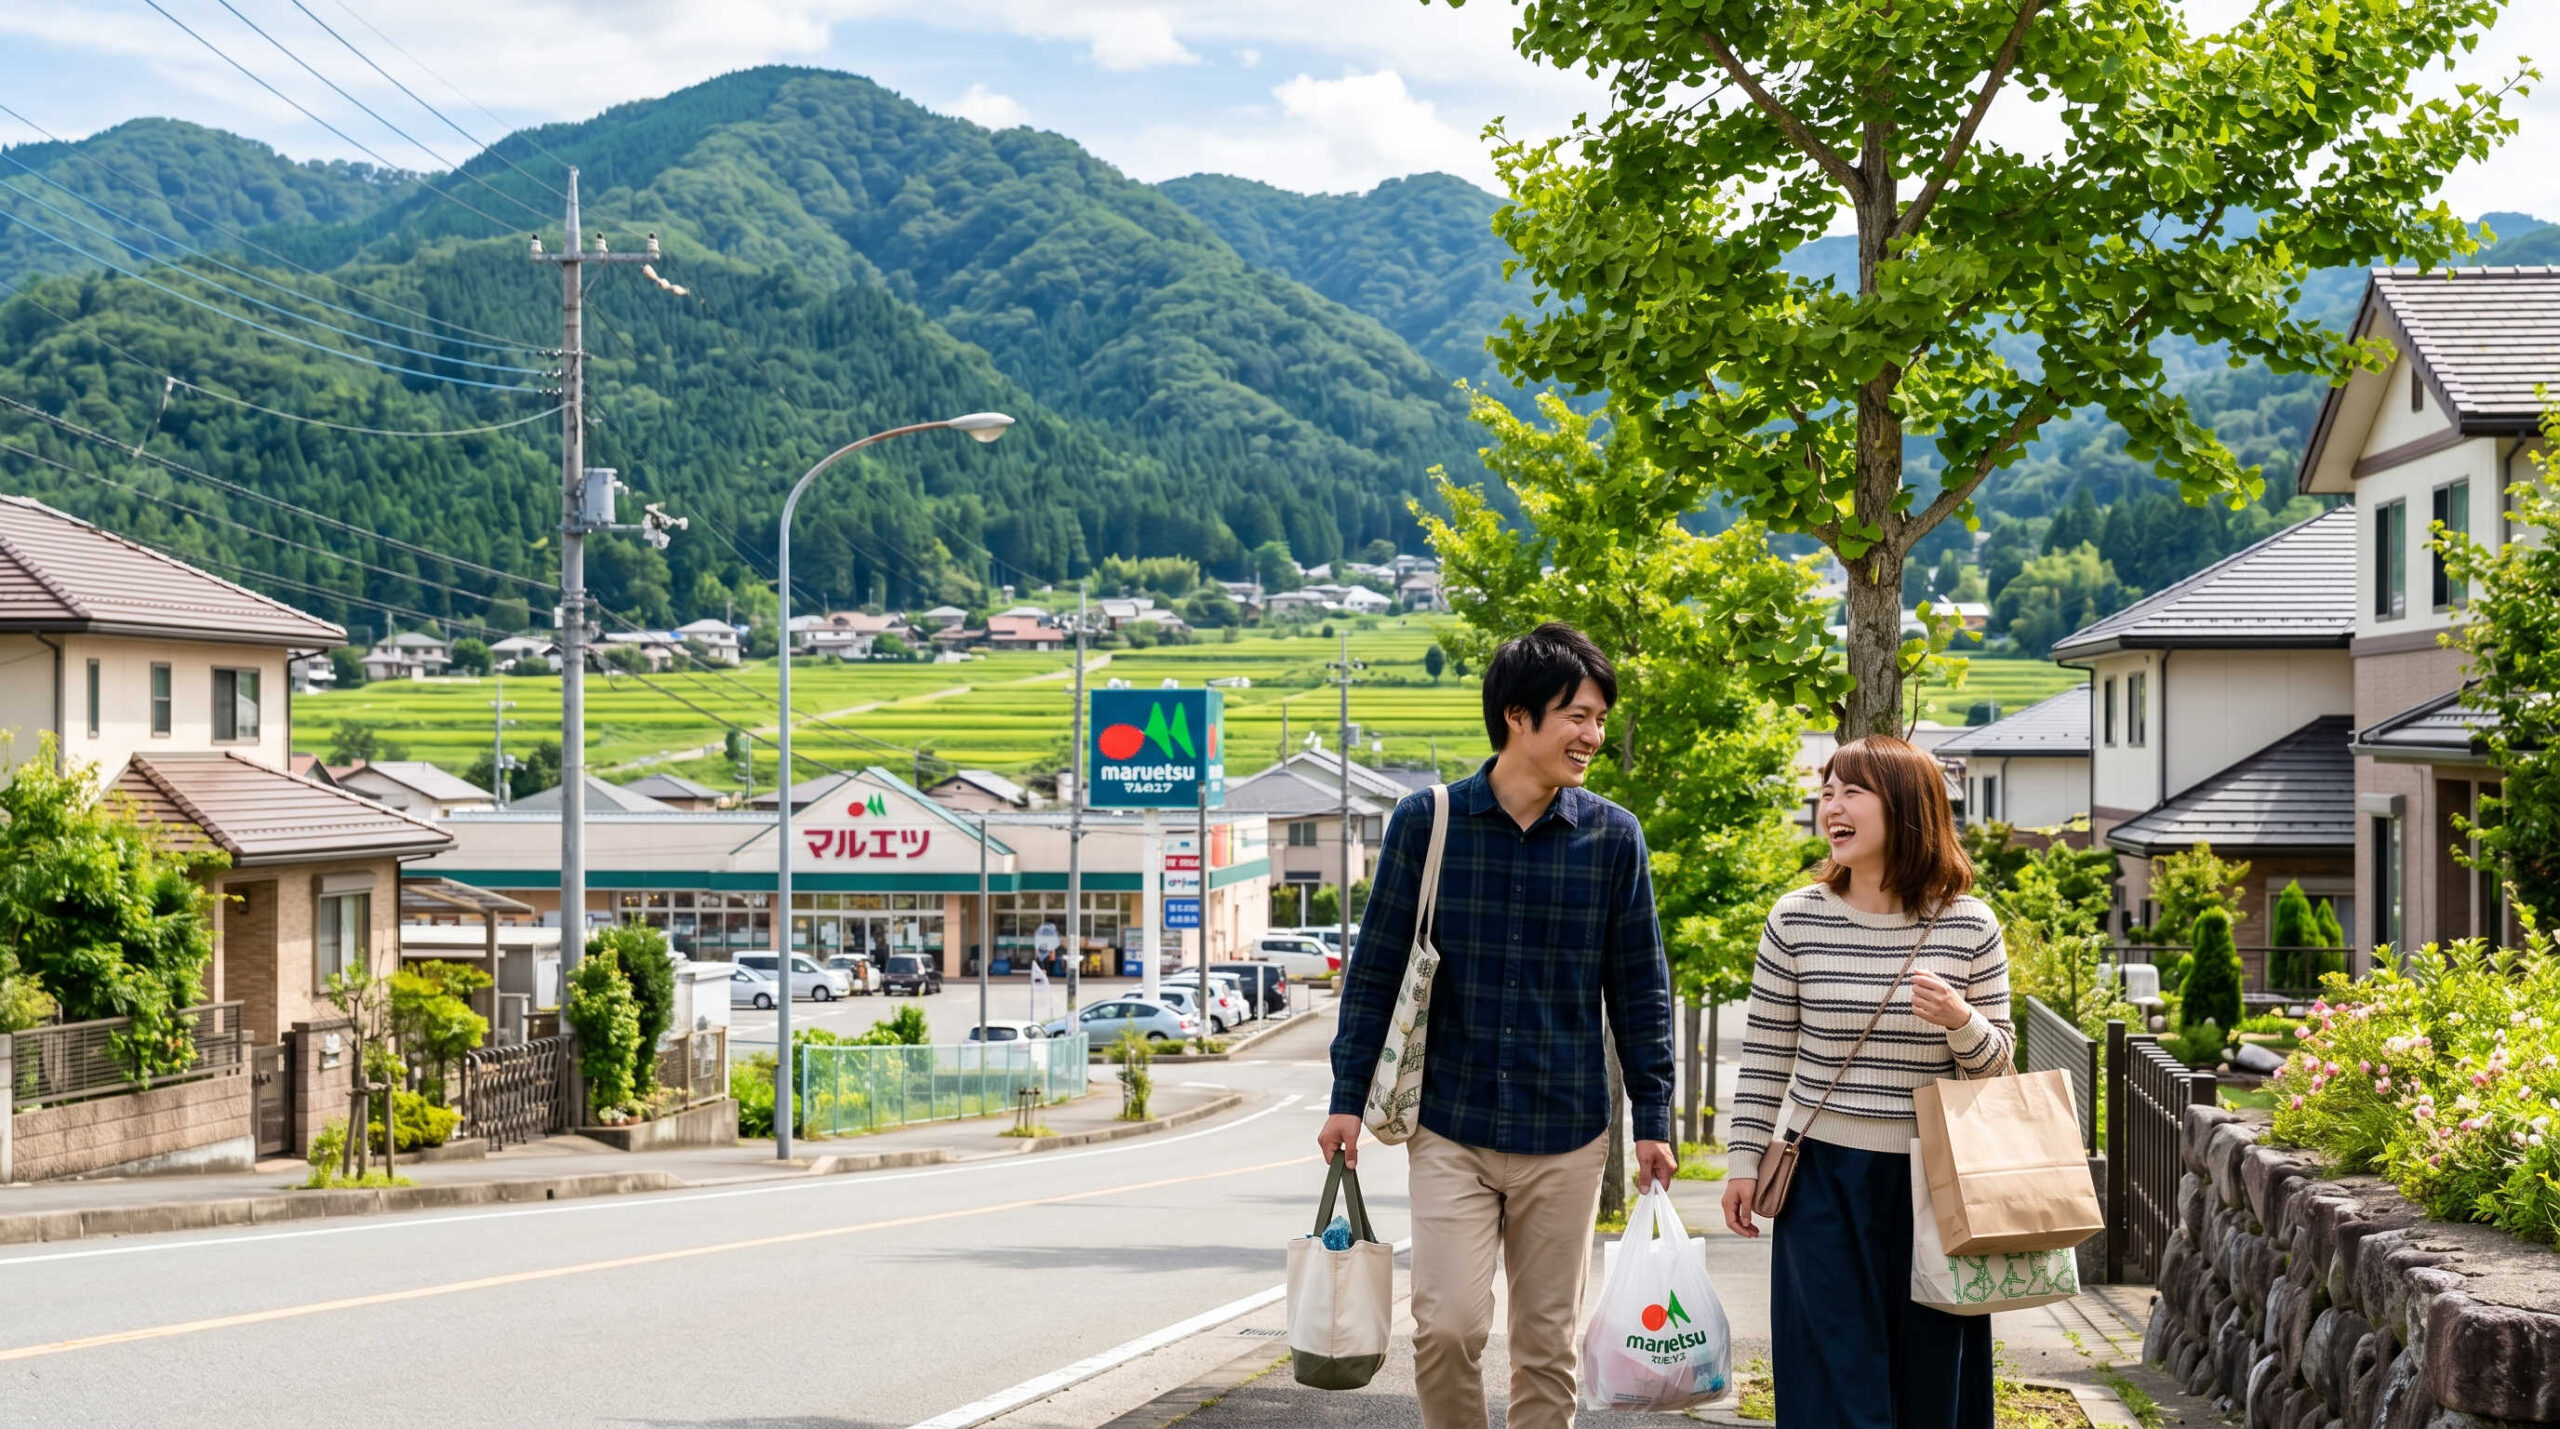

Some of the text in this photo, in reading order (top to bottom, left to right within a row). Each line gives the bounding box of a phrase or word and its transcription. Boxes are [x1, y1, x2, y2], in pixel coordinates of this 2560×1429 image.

[1101, 763, 1196, 780] maruetsu
[803, 829, 930, 860] マルエツ
